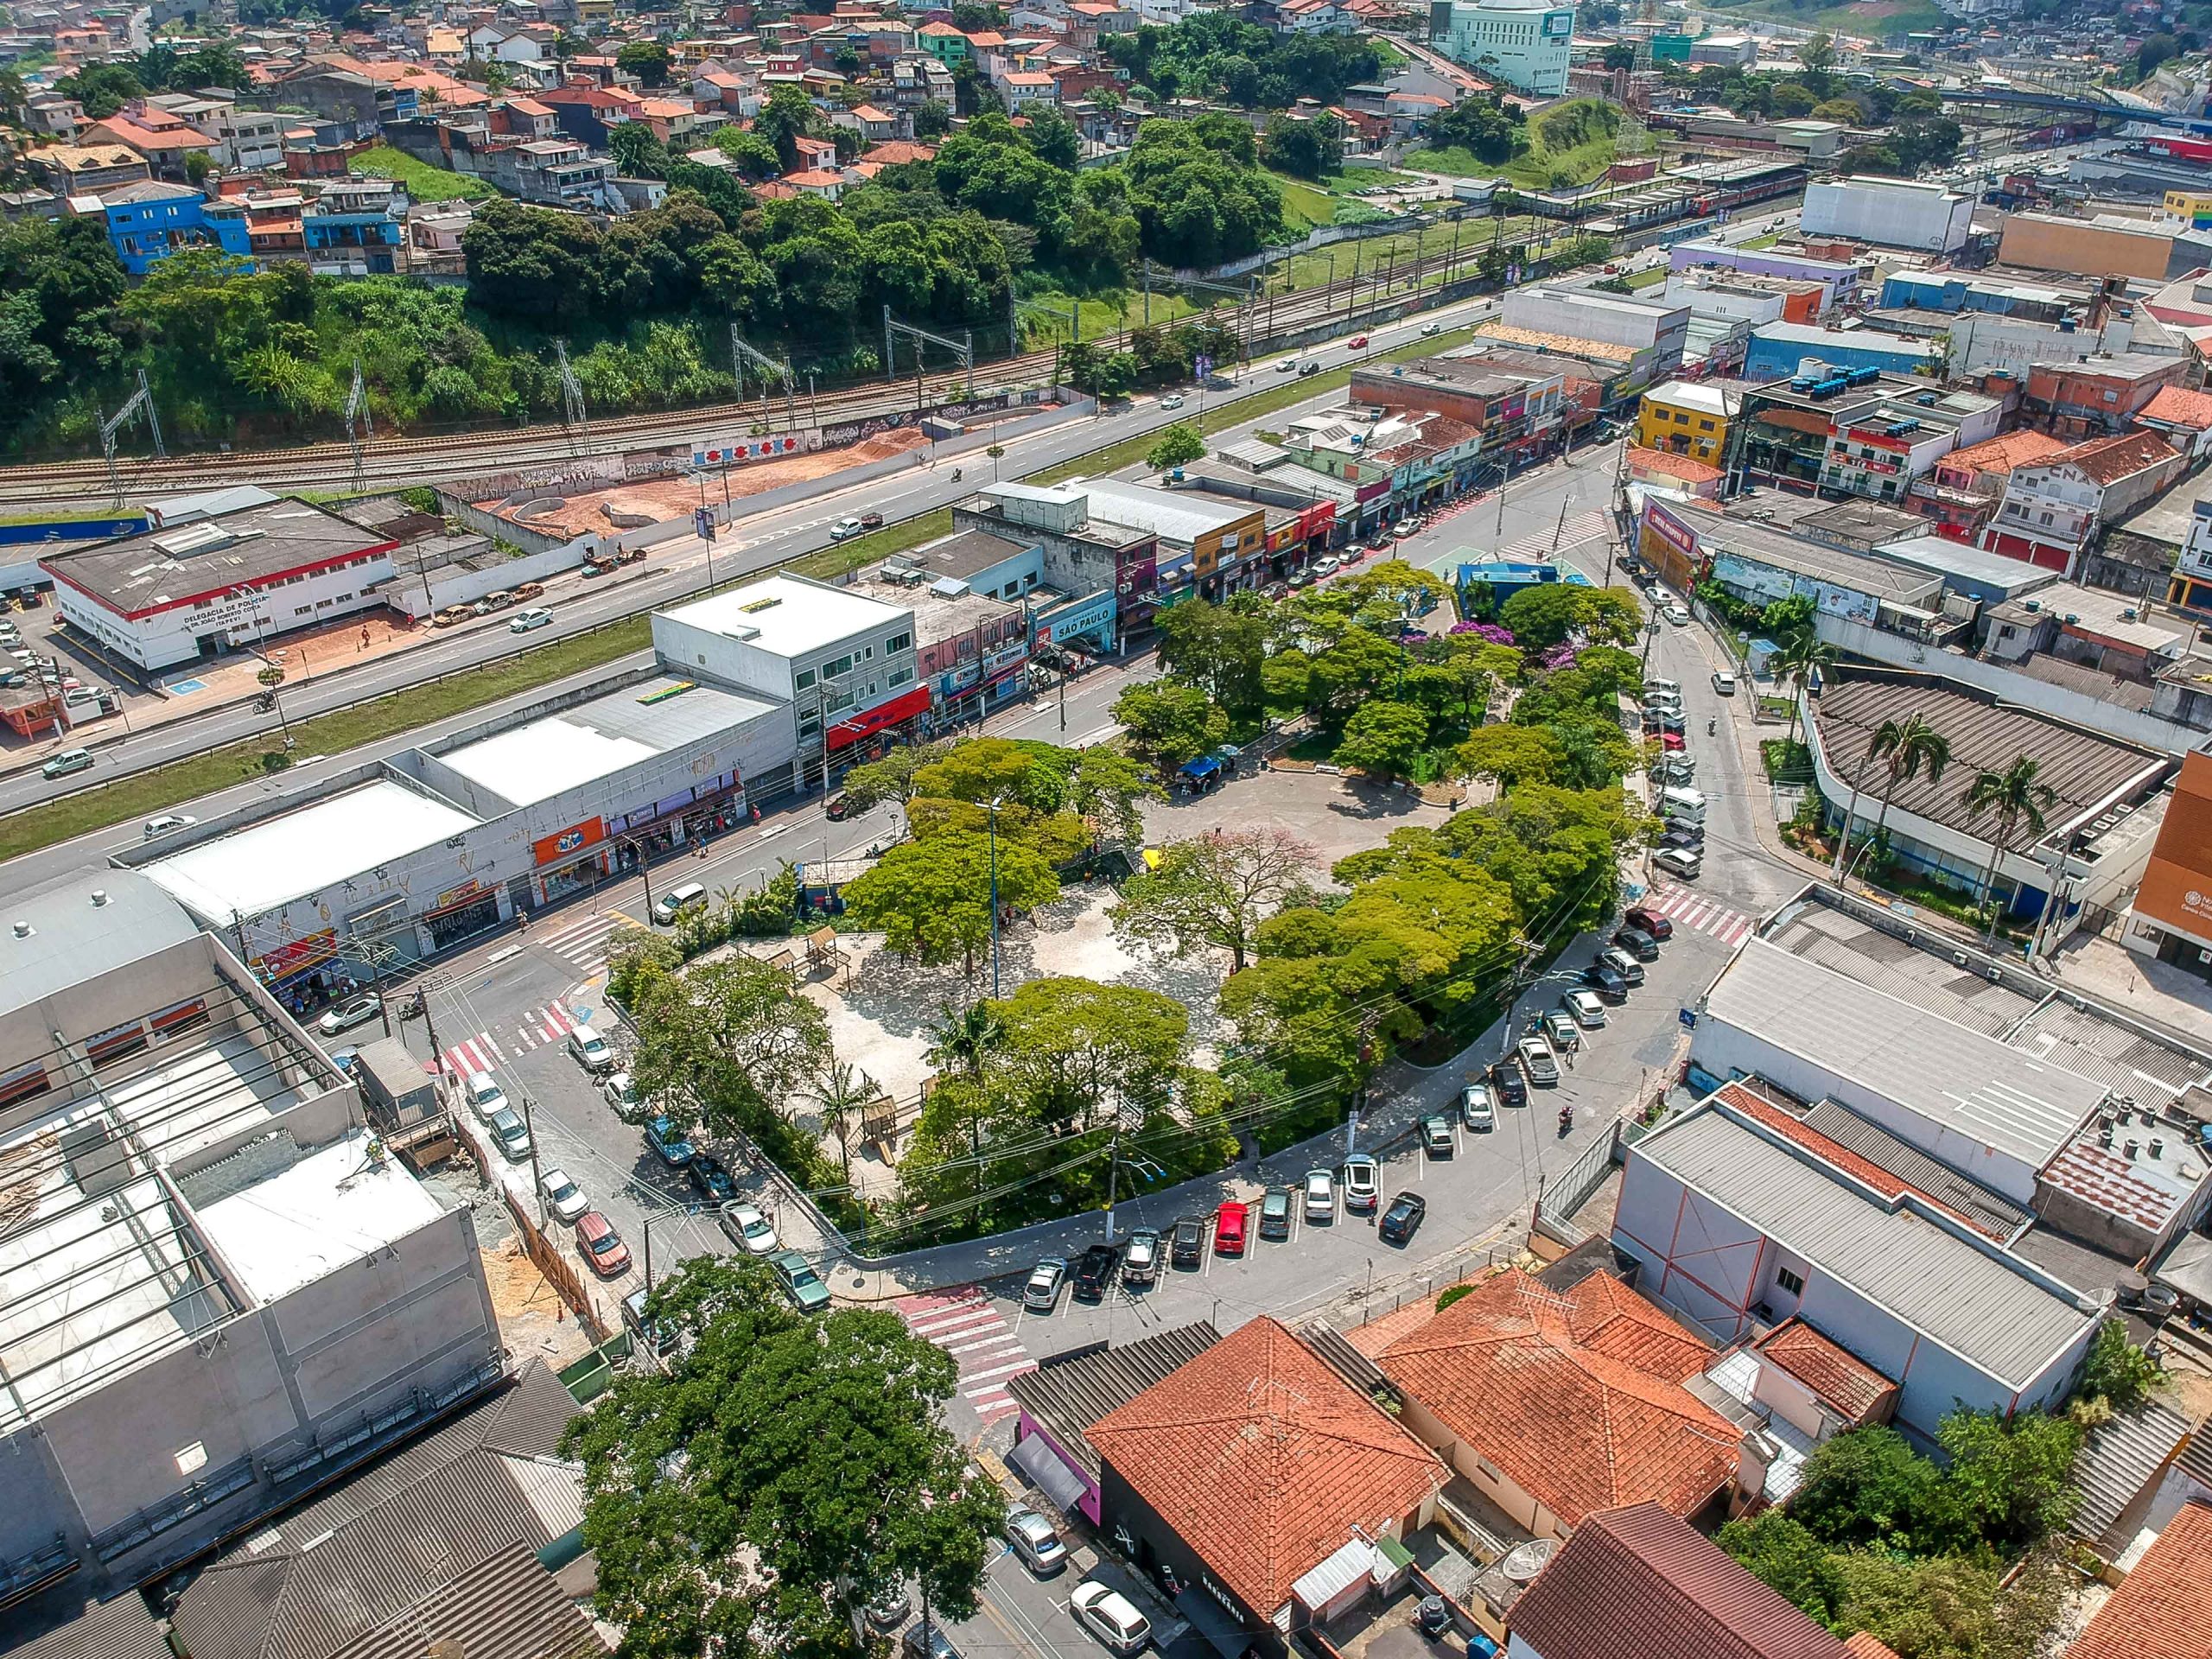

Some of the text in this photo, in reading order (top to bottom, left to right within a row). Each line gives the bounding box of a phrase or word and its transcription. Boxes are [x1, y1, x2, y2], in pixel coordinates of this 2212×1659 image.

[2049, 467, 2090, 486] CNA
[184, 607, 225, 624] DELEGACIA
[226, 604, 236, 613] DE
[200, 616, 216, 626] JOÃO
[217, 610, 242, 621] ROBERTO
[215, 616, 241, 627] ITAPEVI
[1058, 609, 1109, 638] SÃO PAULO
[1038, 633, 1050, 644] SP
